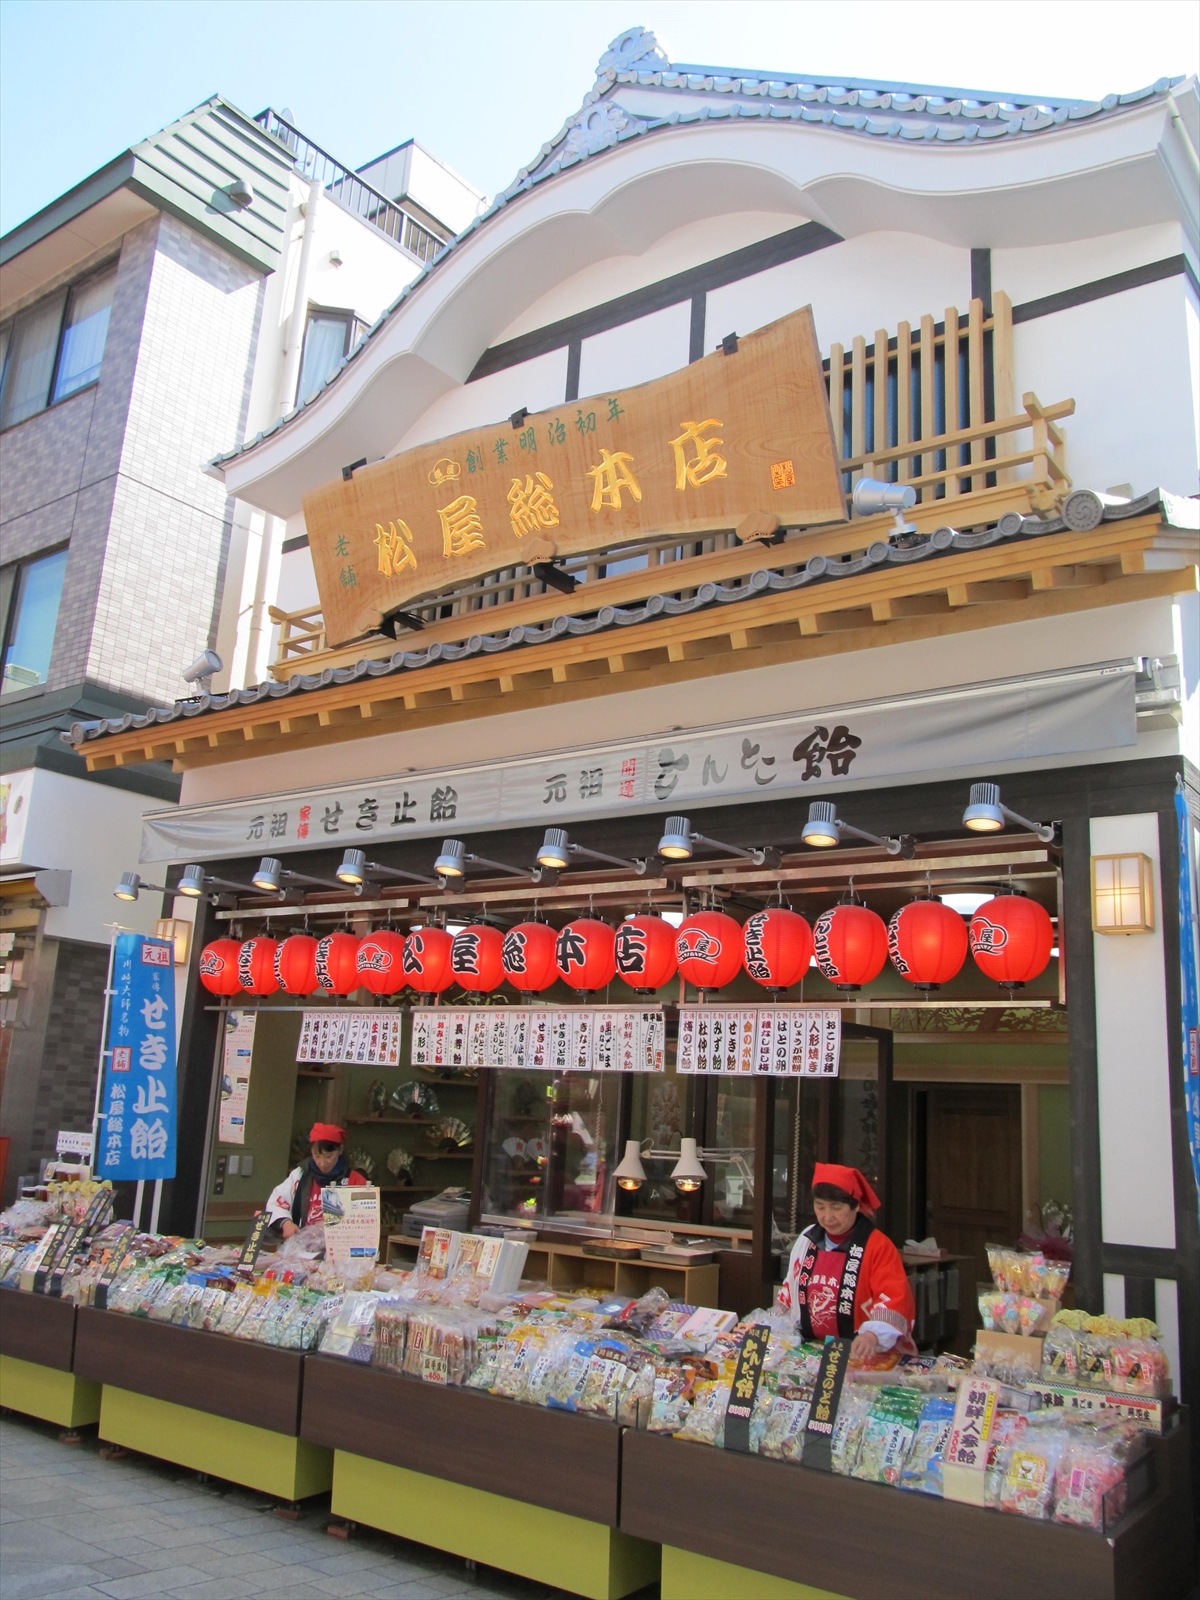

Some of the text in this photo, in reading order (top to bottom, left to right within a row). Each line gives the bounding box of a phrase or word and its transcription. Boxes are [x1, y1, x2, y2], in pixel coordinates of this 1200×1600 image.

[465, 398, 625, 475] 創業明治初年
[373, 417, 728, 579] 松屋総本店
[543, 768, 604, 804] 元祖
[618, 758, 636, 799] 開運
[654, 725, 862, 800] とんとこ飴
[246, 812, 289, 840] 元祖
[319, 785, 459, 835] せき止飴
[143, 947, 171, 965] 元祖
[315, 937, 335, 989] せき止飴
[744, 911, 772, 980] せき止飴
[117, 959, 133, 1038] 川崎大師名物
[357, 1020, 369, 1061] ハッカ飴
[416, 1022, 426, 1063] 人形飴
[533, 1022, 546, 1066] せき止飴
[556, 1022, 566, 1066] せきのど飴
[578, 1022, 587, 1067] きなこ飴
[681, 1020, 693, 1070] 梅のど飴
[697, 1020, 708, 1070] 杜仲飴
[712, 1020, 723, 1070] みず飴
[726, 1020, 738, 1071] せき飴
[741, 1020, 753, 1071] 金の水飴
[758, 1020, 772, 1072] 種なしほし梅
[775, 1020, 787, 1072] はとの卵
[808, 1020, 820, 1073] 人形焼き
[823, 1020, 836, 1073] おこし各種
[130, 994, 170, 1160] せき止飴
[105, 1083, 127, 1166] 松屋総本店
[243, 1220, 264, 1263] せき止飴
[838, 1243, 864, 1316] 松屋総本店
[735, 1339, 760, 1399] とんとこ飴
[815, 1350, 842, 1421] せきのど飴
[971, 1381, 990, 1390] 名物
[728, 1404, 751, 1418] 500円
[808, 1420, 833, 1435] 500円
[948, 1430, 960, 1462] 500円
